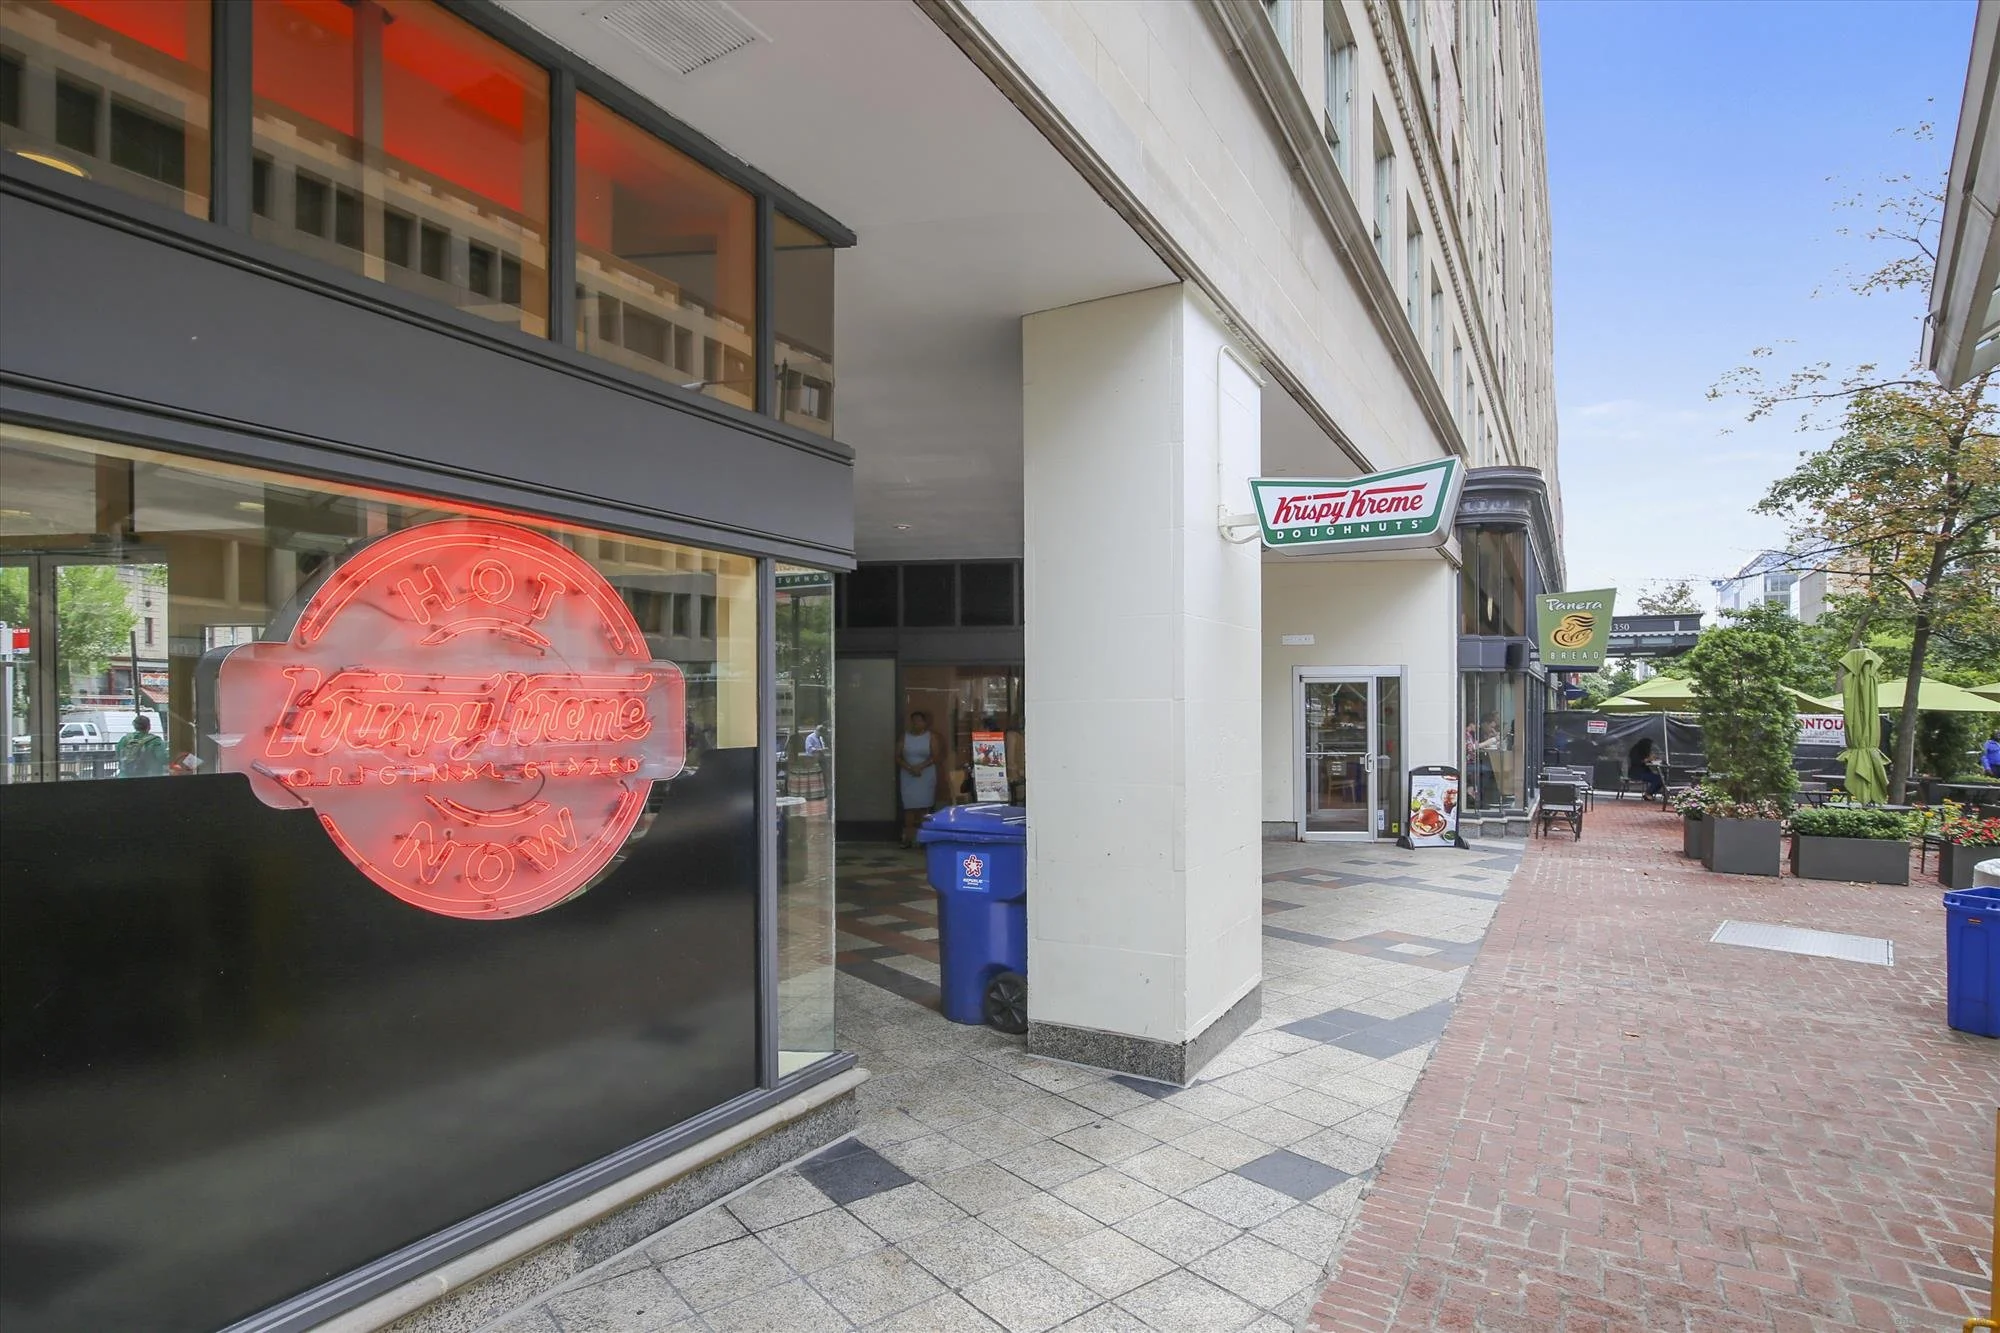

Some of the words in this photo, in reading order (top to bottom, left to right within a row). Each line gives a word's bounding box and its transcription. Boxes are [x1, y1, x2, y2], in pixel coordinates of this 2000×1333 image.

[1272, 491, 1349, 525] Krispy
[1346, 482, 1428, 518] Kreme
[1277, 520, 1418, 539] DOUGHNUTS
[398, 559, 566, 624] HOT
[1546, 599, 1603, 612] Panera
[1550, 651, 1599, 660] BREAD
[265, 668, 500, 760] Krispy
[492, 672, 653, 747] Kreme
[1794, 718, 1844, 730] ONTOU
[287, 762, 500, 788] ORIGINAL
[523, 756, 643, 779] GLAZED
[393, 808, 580, 894] NOW
